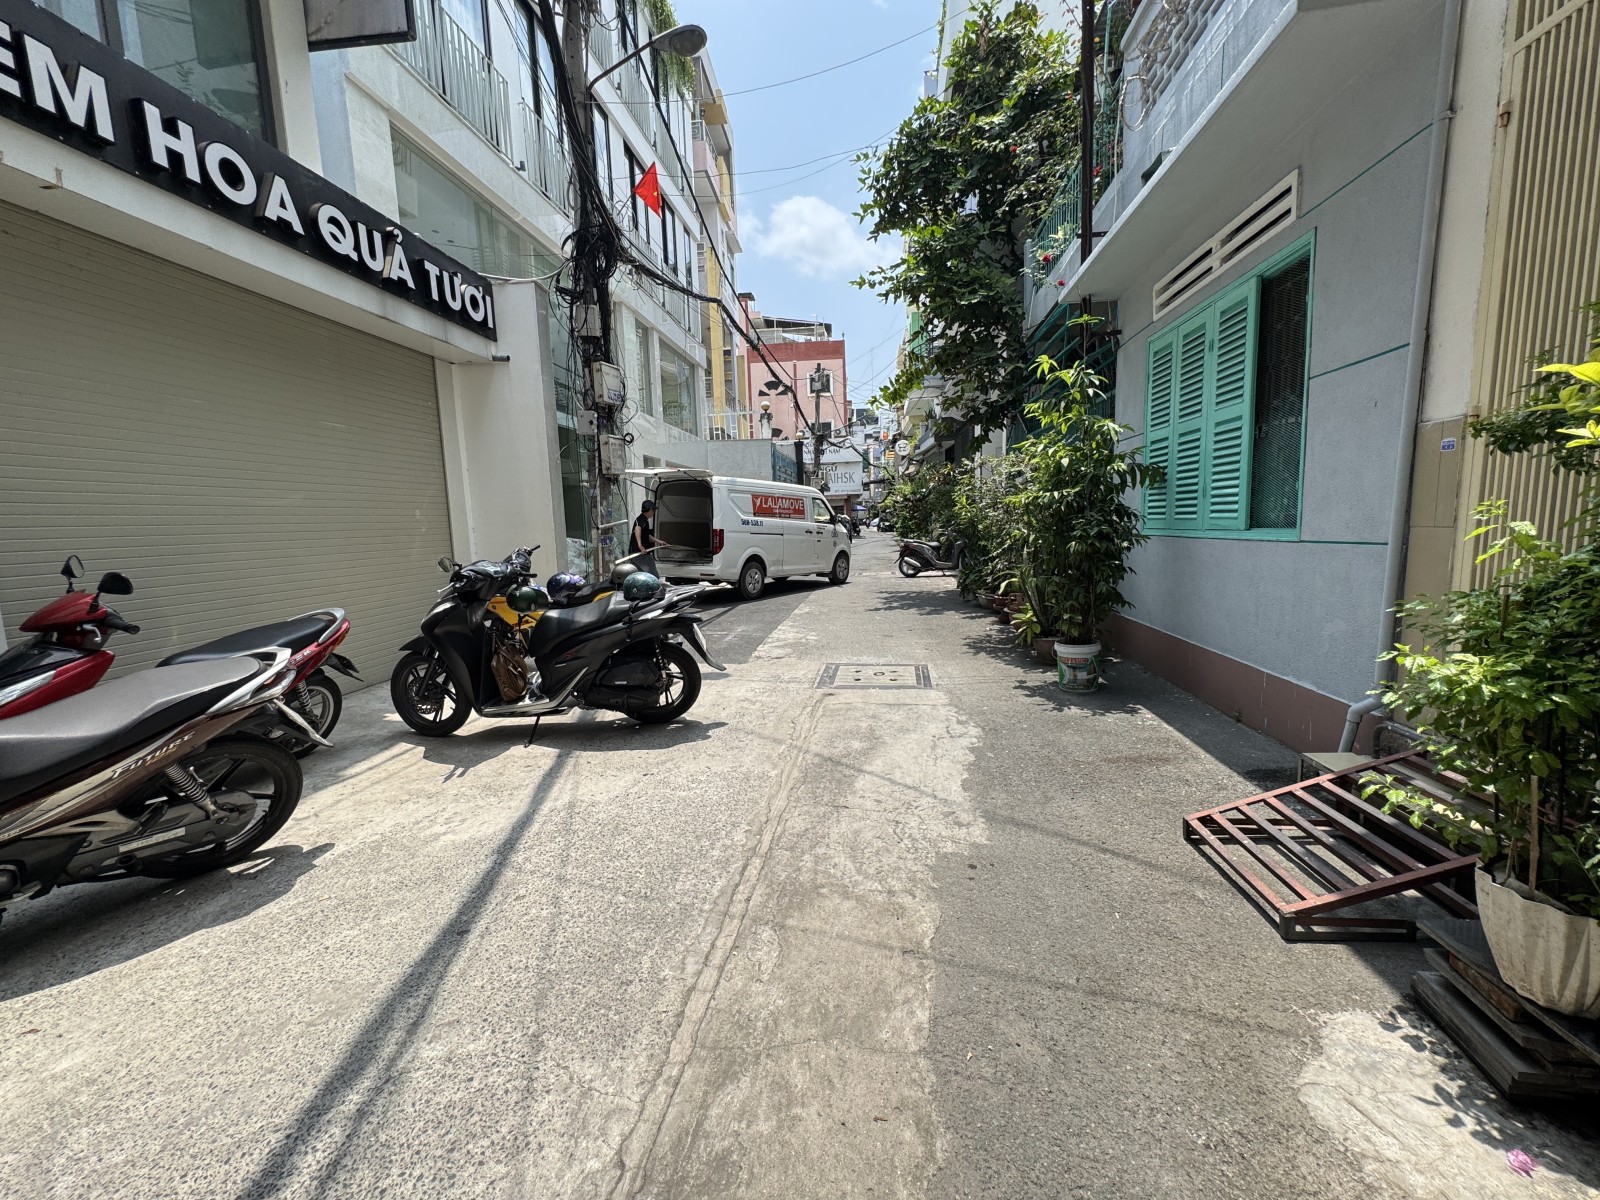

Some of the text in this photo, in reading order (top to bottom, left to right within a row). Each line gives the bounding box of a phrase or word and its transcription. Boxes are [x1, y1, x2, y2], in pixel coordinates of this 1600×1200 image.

[142, 100, 305, 237] HOA
[317, 204, 416, 291] QUẢ
[424, 259, 495, 329] TƯƠI
[762, 497, 804, 510] LALAMOVE
[111, 731, 196, 779] FUTURE
